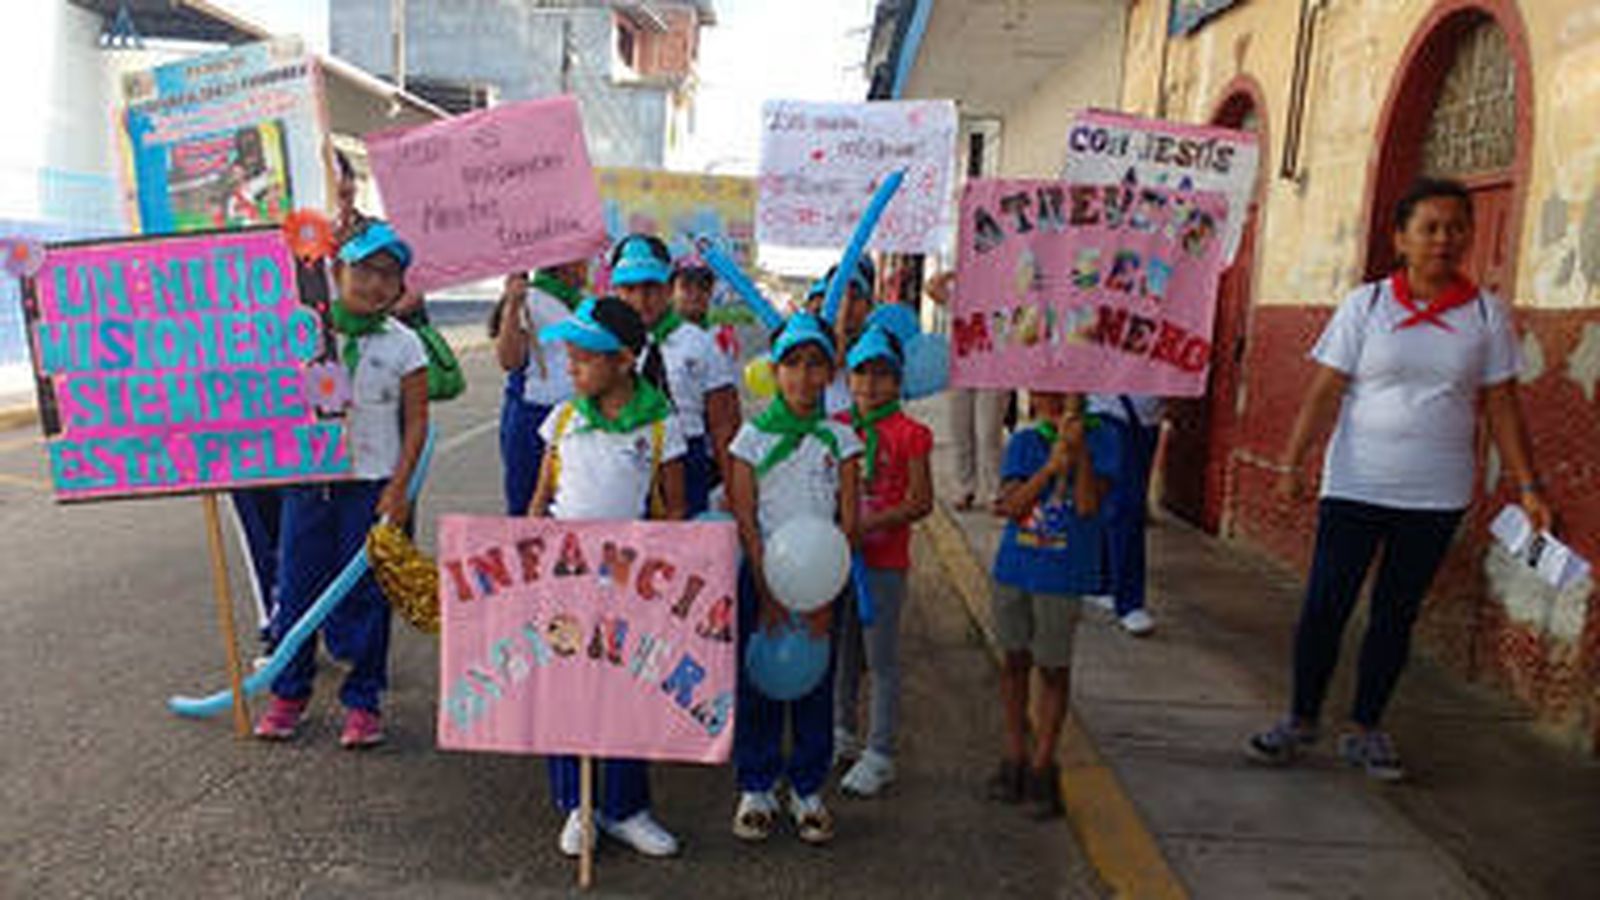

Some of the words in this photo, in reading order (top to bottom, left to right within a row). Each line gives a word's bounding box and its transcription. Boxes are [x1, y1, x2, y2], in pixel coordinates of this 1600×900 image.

[55, 263, 132, 316] UN
[147, 246, 282, 314] NIÑO
[37, 306, 319, 375] MISIONERO
[67, 366, 304, 428] SIEMPRE
[190, 424, 353, 484] FELIZ
[445, 531, 733, 643] INFANCIA
